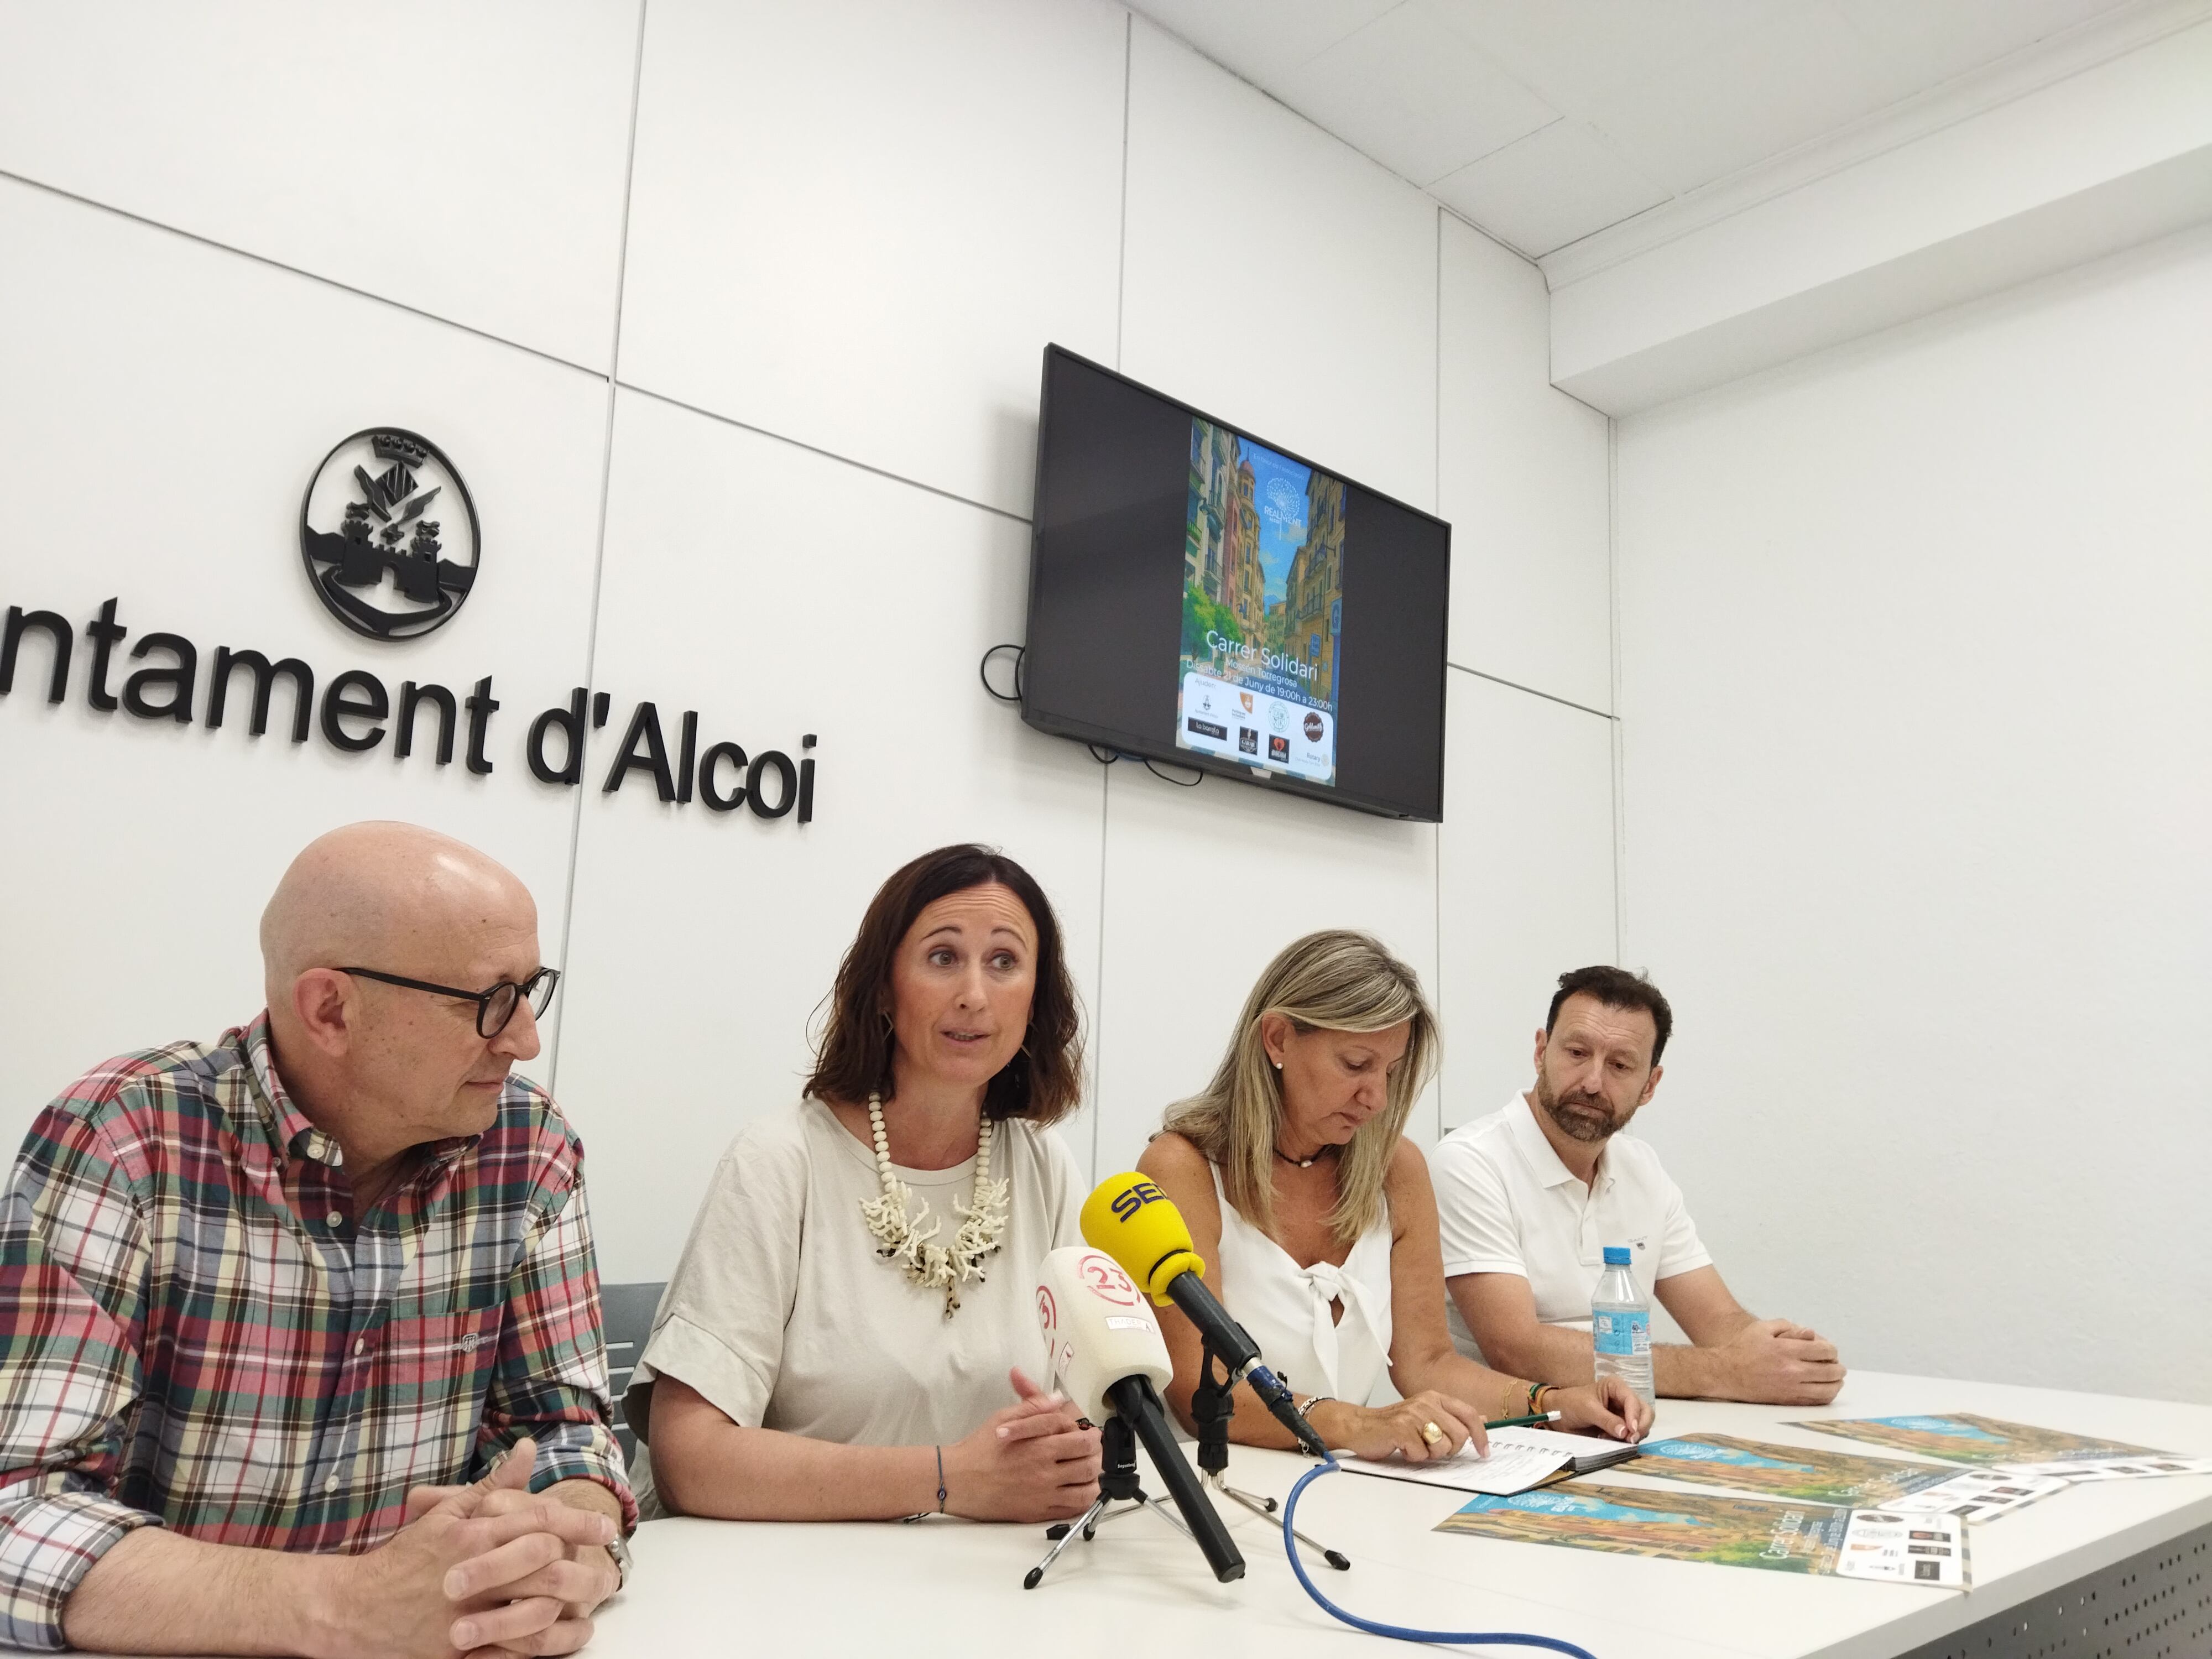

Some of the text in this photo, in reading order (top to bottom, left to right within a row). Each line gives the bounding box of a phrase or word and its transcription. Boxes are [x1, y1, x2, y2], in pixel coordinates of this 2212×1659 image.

[1264, 505, 1302, 528] REALMENT
[1207, 630, 1317, 681] Carrer Solidari
[1186, 659, 1222, 677] Dissabte
[1233, 674, 1243, 684] de
[1245, 677, 1264, 692] Juny
[1265, 684, 1275, 693] de
[1277, 686, 1301, 701] 19:00h
[1308, 696, 1332, 712] 23:00h
[1195, 677, 1217, 689] Ajuden:
[1258, 667, 1297, 687] Torregrosa
[0, 597, 817, 823] ntament d'Alcoi
[1307, 753, 1321, 762] Rotary
[1087, 1266, 1132, 1292] 23
